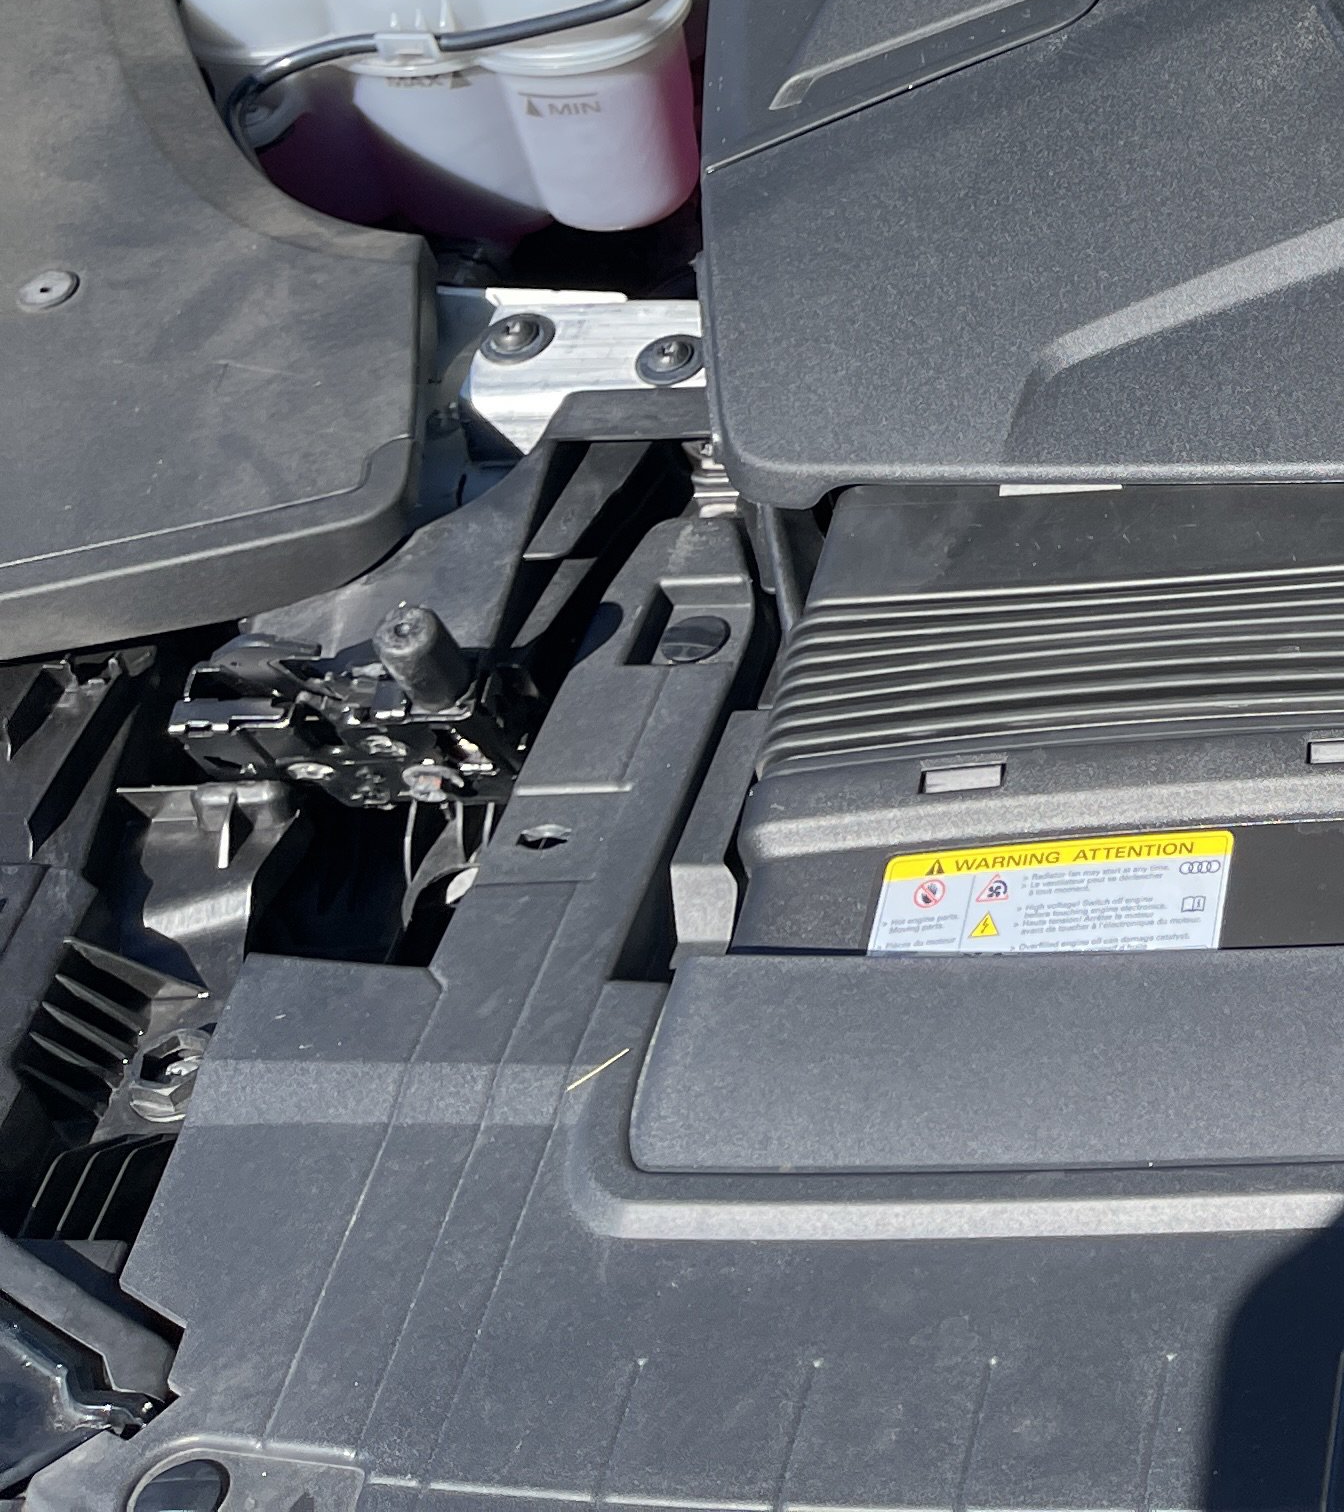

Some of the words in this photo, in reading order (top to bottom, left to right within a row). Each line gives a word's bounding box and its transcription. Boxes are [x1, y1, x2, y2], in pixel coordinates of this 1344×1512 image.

[547, 100, 602, 116] MIN
[955, 851, 1060, 872] WARNING
[1073, 842, 1195, 862] ATTENTION
[1083, 870, 1100, 878] may
[1025, 904, 1044, 913] High
[1083, 898, 1110, 907] Switch
